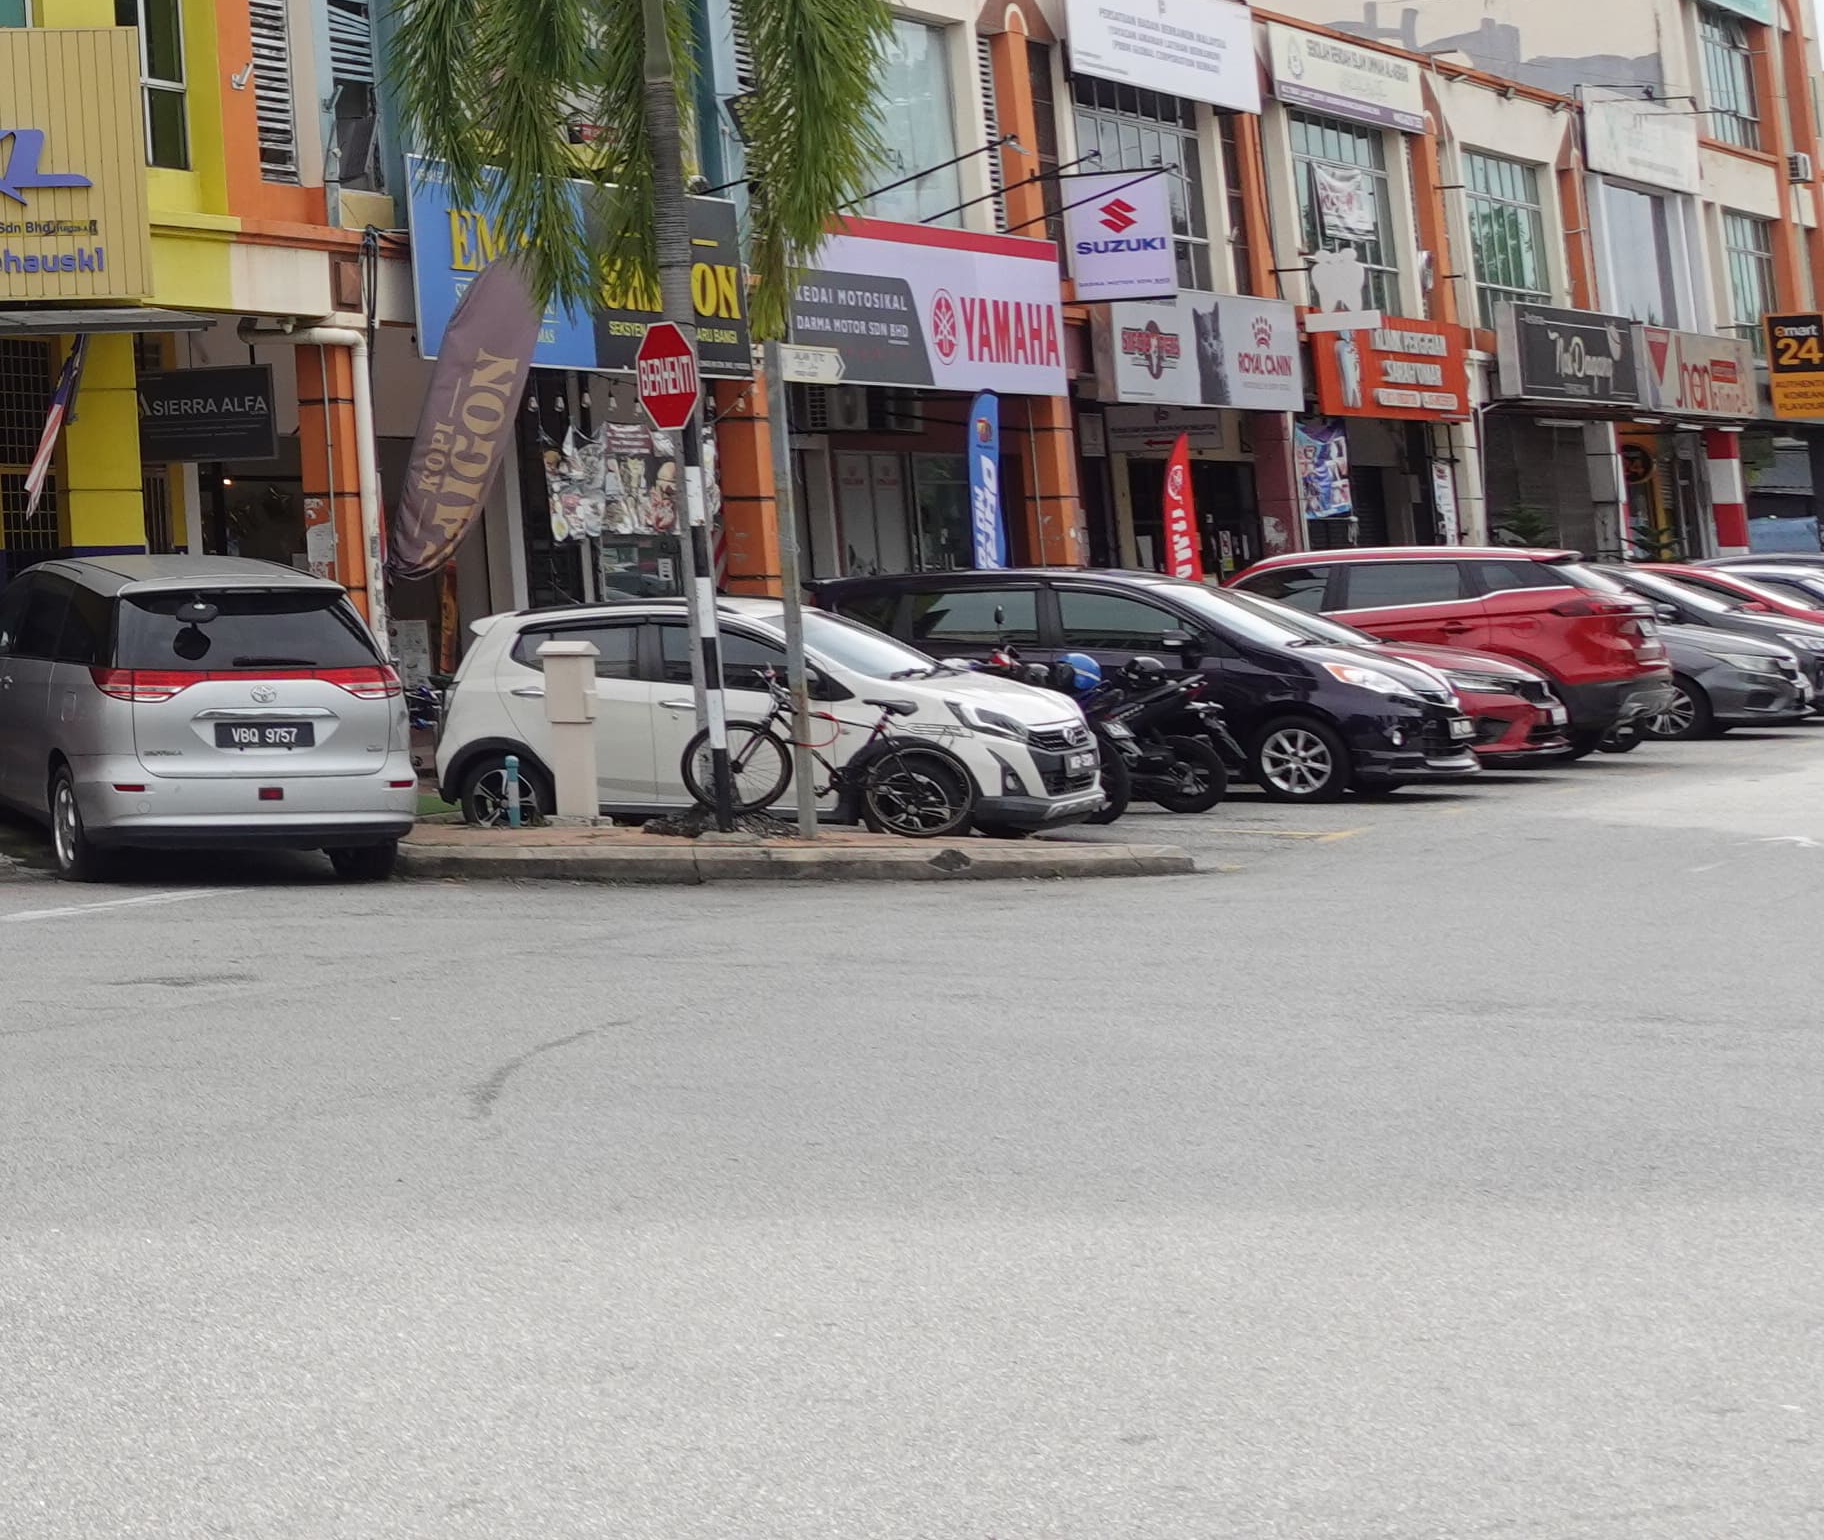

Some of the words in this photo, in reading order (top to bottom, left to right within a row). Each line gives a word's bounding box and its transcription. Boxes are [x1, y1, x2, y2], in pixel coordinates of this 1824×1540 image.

[1076, 236, 1166, 256] SUZUKI
[793, 284, 834, 306] KEDAI
[837, 288, 908, 312] MOTOSIKAL
[796, 315, 832, 334] DARMA
[834, 318, 867, 337] MOTOR
[869, 321, 888, 338] SDN
[959, 296, 1062, 368] YAMAHA
[1774, 325, 1819, 337] emart
[1238, 351, 1264, 376] ROYAL
[1265, 353, 1293, 377] CANIN
[1776, 337, 1824, 366] 24
[638, 355, 697, 397] BERHENTI
[152, 397, 218, 416] SIERRA
[221, 395, 268, 413] ALFA
[418, 421, 455, 494] KOPI
[231, 727, 260, 744] VBQ
[265, 726, 298, 743] 9757
